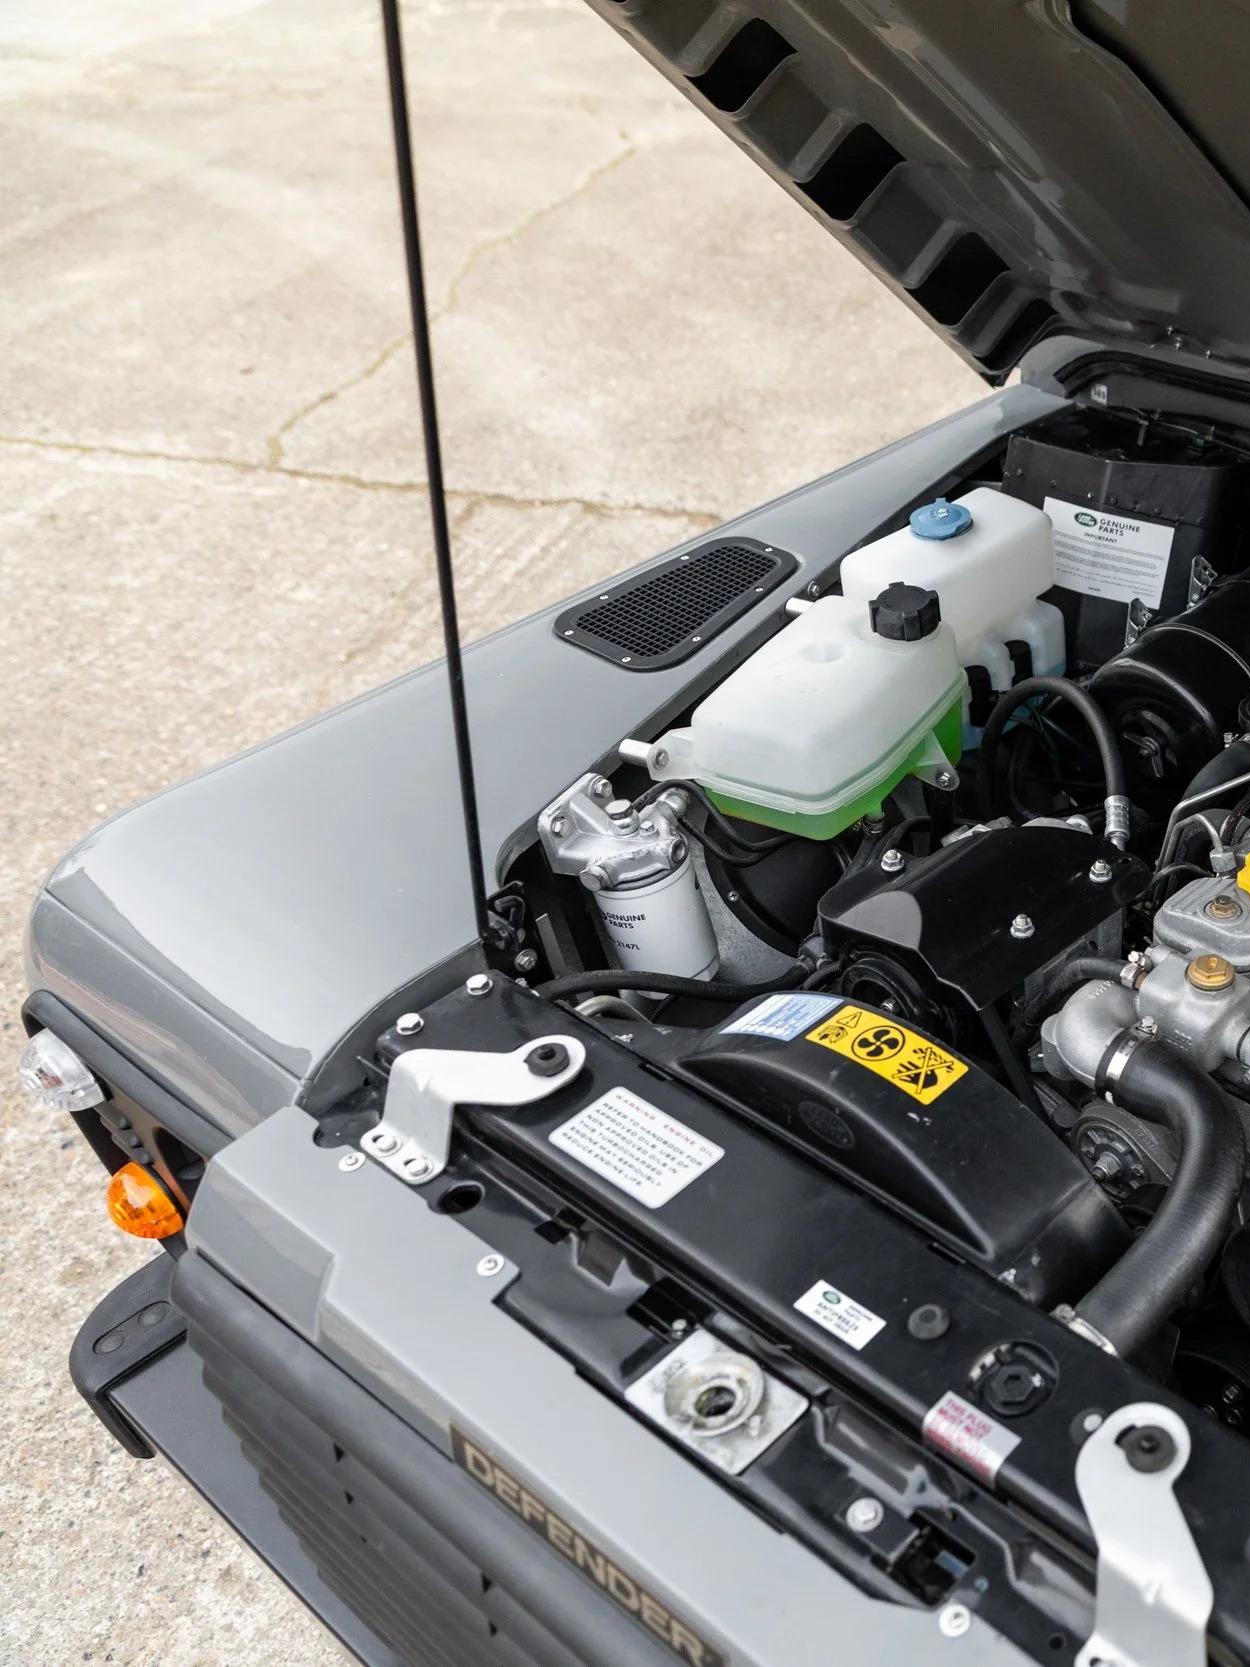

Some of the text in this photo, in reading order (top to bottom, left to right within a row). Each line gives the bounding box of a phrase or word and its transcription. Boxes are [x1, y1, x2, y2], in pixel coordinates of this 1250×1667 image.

[1098, 525, 1124, 537] PARTS
[1100, 518, 1141, 533] GENUINE
[1084, 532, 1118, 544] IMPORTANT
[606, 912, 647, 921] GENUINE
[609, 919, 634, 929] PARTS
[615, 1093, 656, 1121] WARNING
[663, 1124, 696, 1146] ENGINE
[603, 1102, 703, 1167] REFER TO HANDBOOK FOR
[463, 1442, 706, 1667] DEFENDER
